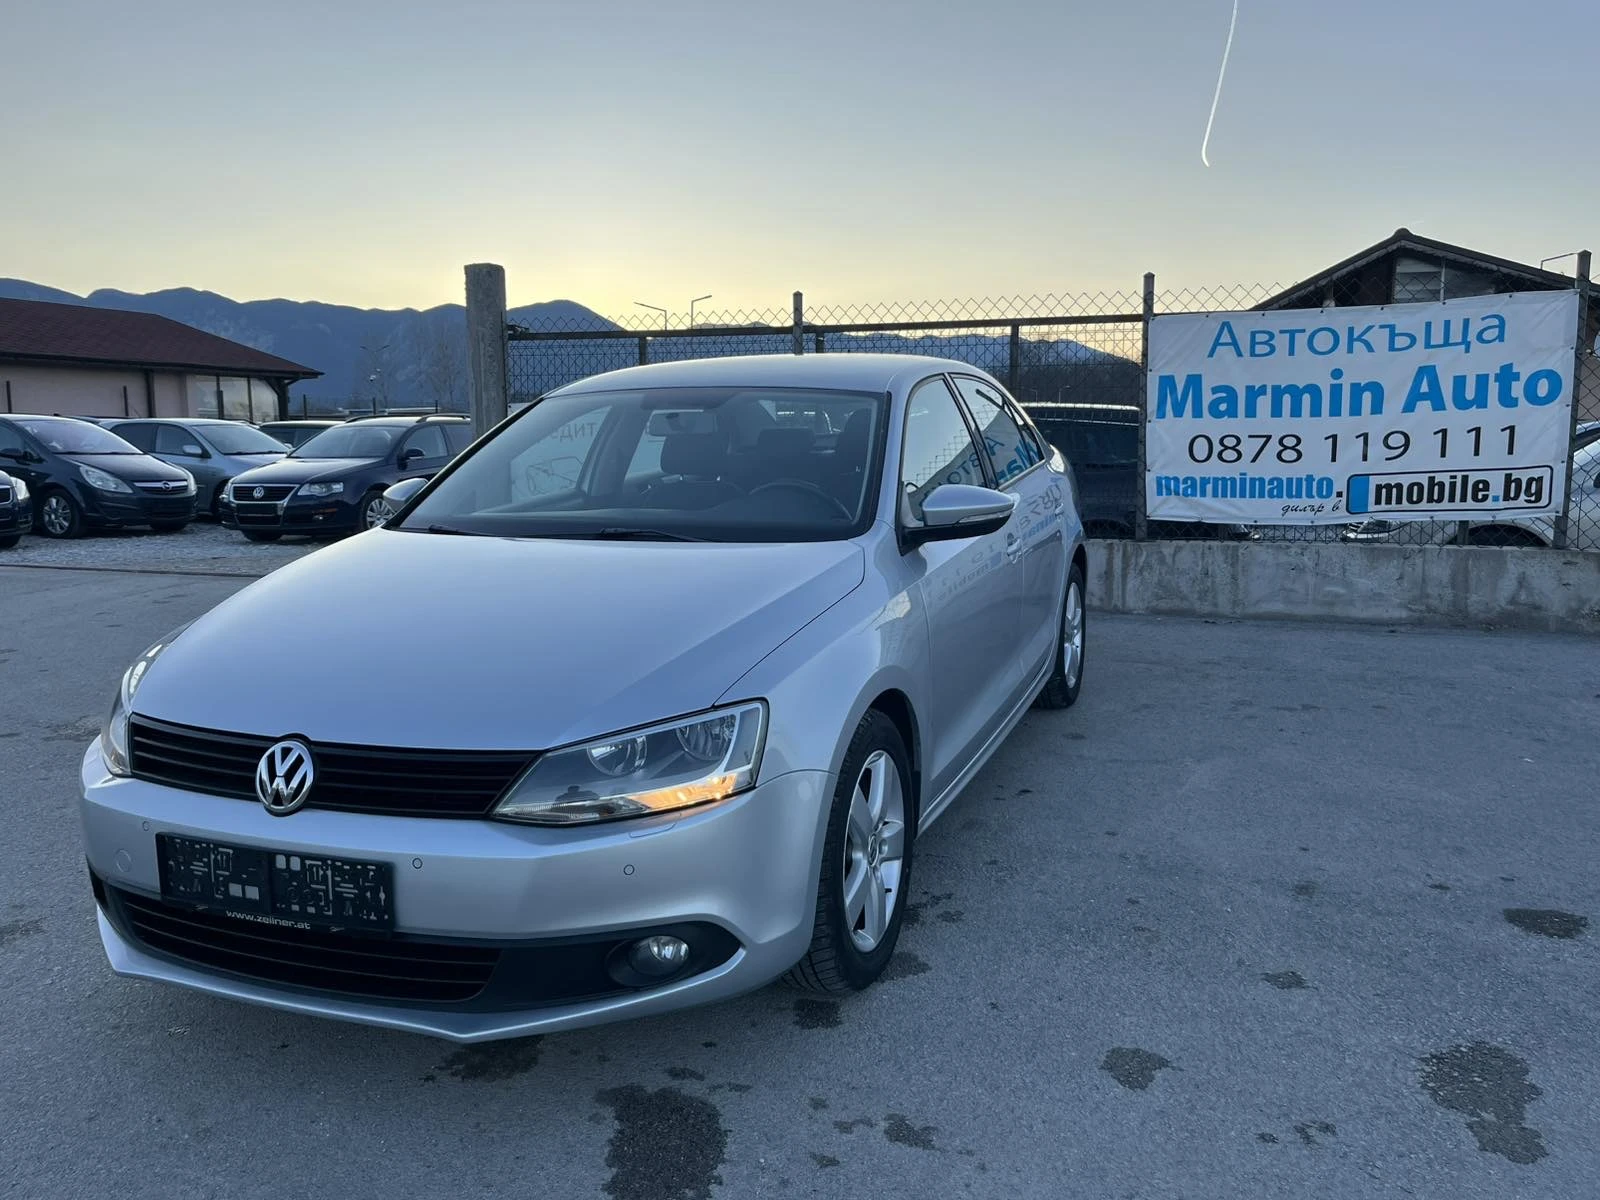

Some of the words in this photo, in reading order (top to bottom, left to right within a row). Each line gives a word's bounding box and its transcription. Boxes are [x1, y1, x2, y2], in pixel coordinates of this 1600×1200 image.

[1207, 313, 1506, 359] Автокъща
[1156, 368, 1385, 419] Marmin
[1402, 362, 1563, 414] Auto
[1188, 434, 1303, 464] 0878
[1324, 430, 1411, 463] 119
[1433, 424, 1516, 458] 111
[1374, 473, 1544, 504] mobile.bg
[1281, 503, 1325, 517] дилър
